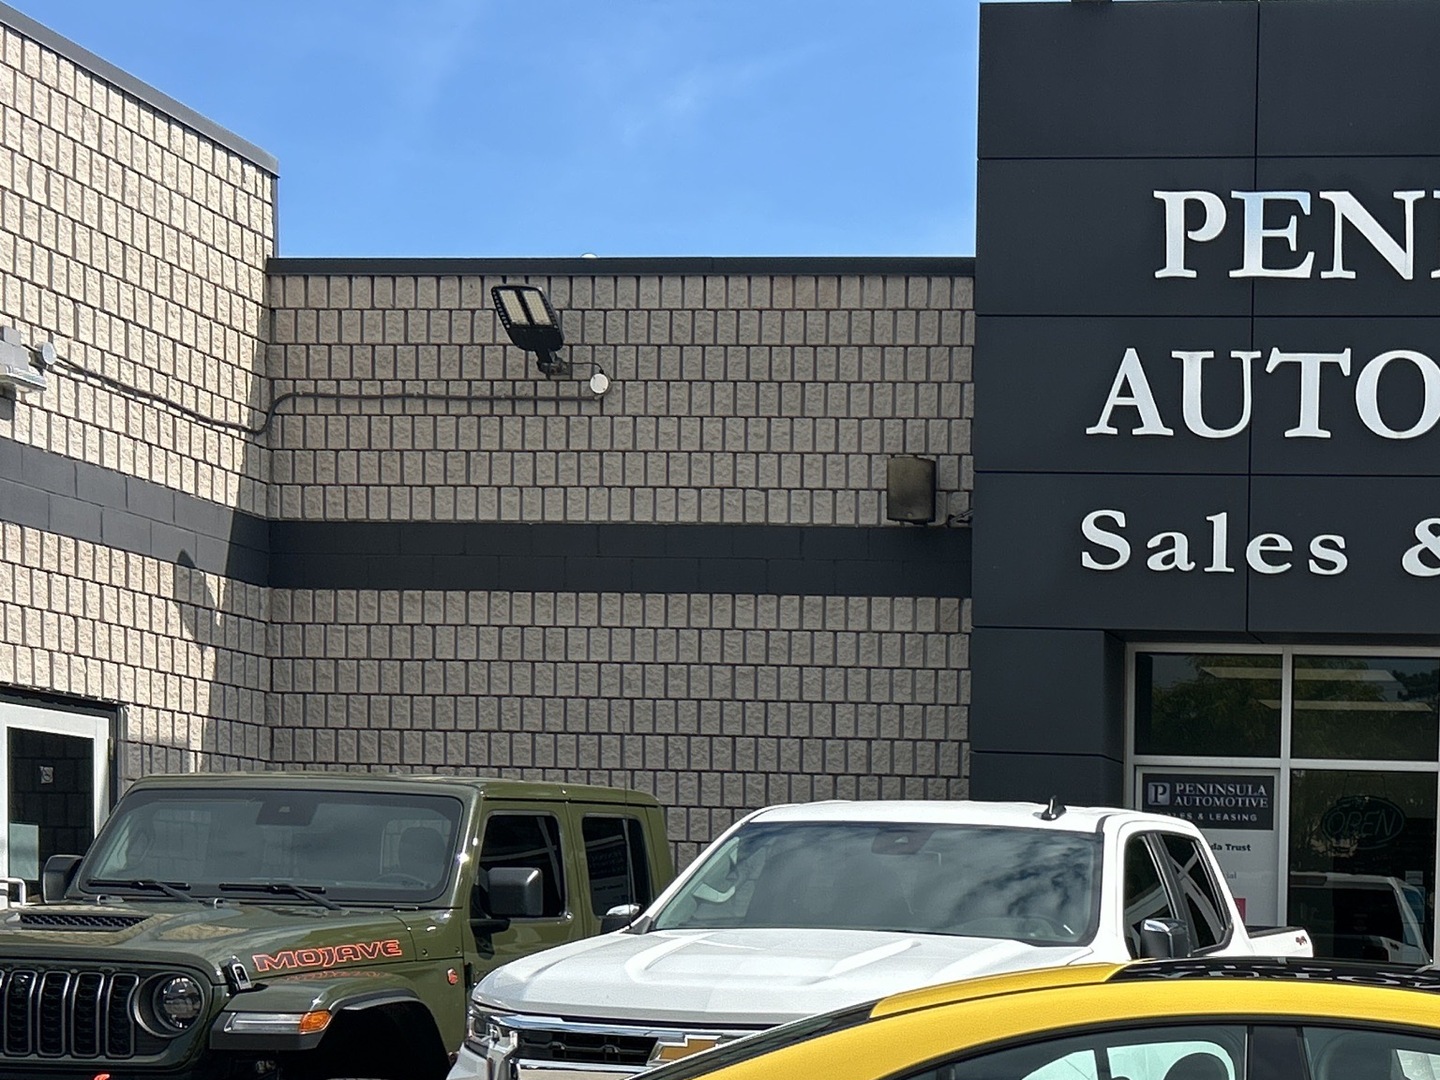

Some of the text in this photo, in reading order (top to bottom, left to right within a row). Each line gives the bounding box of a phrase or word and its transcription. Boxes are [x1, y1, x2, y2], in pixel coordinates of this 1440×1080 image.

[1081, 510, 1349, 577] Sales
[1152, 784, 1167, 803] P
[1175, 783, 1267, 796] PENINSULA
[1174, 796, 1268, 808] AUTOMOTIVE
[1197, 812, 1204, 820] &
[1209, 812, 1258, 821] LEASING
[1225, 843, 1252, 852] Trust
[252, 939, 403, 973] MOJAVE
